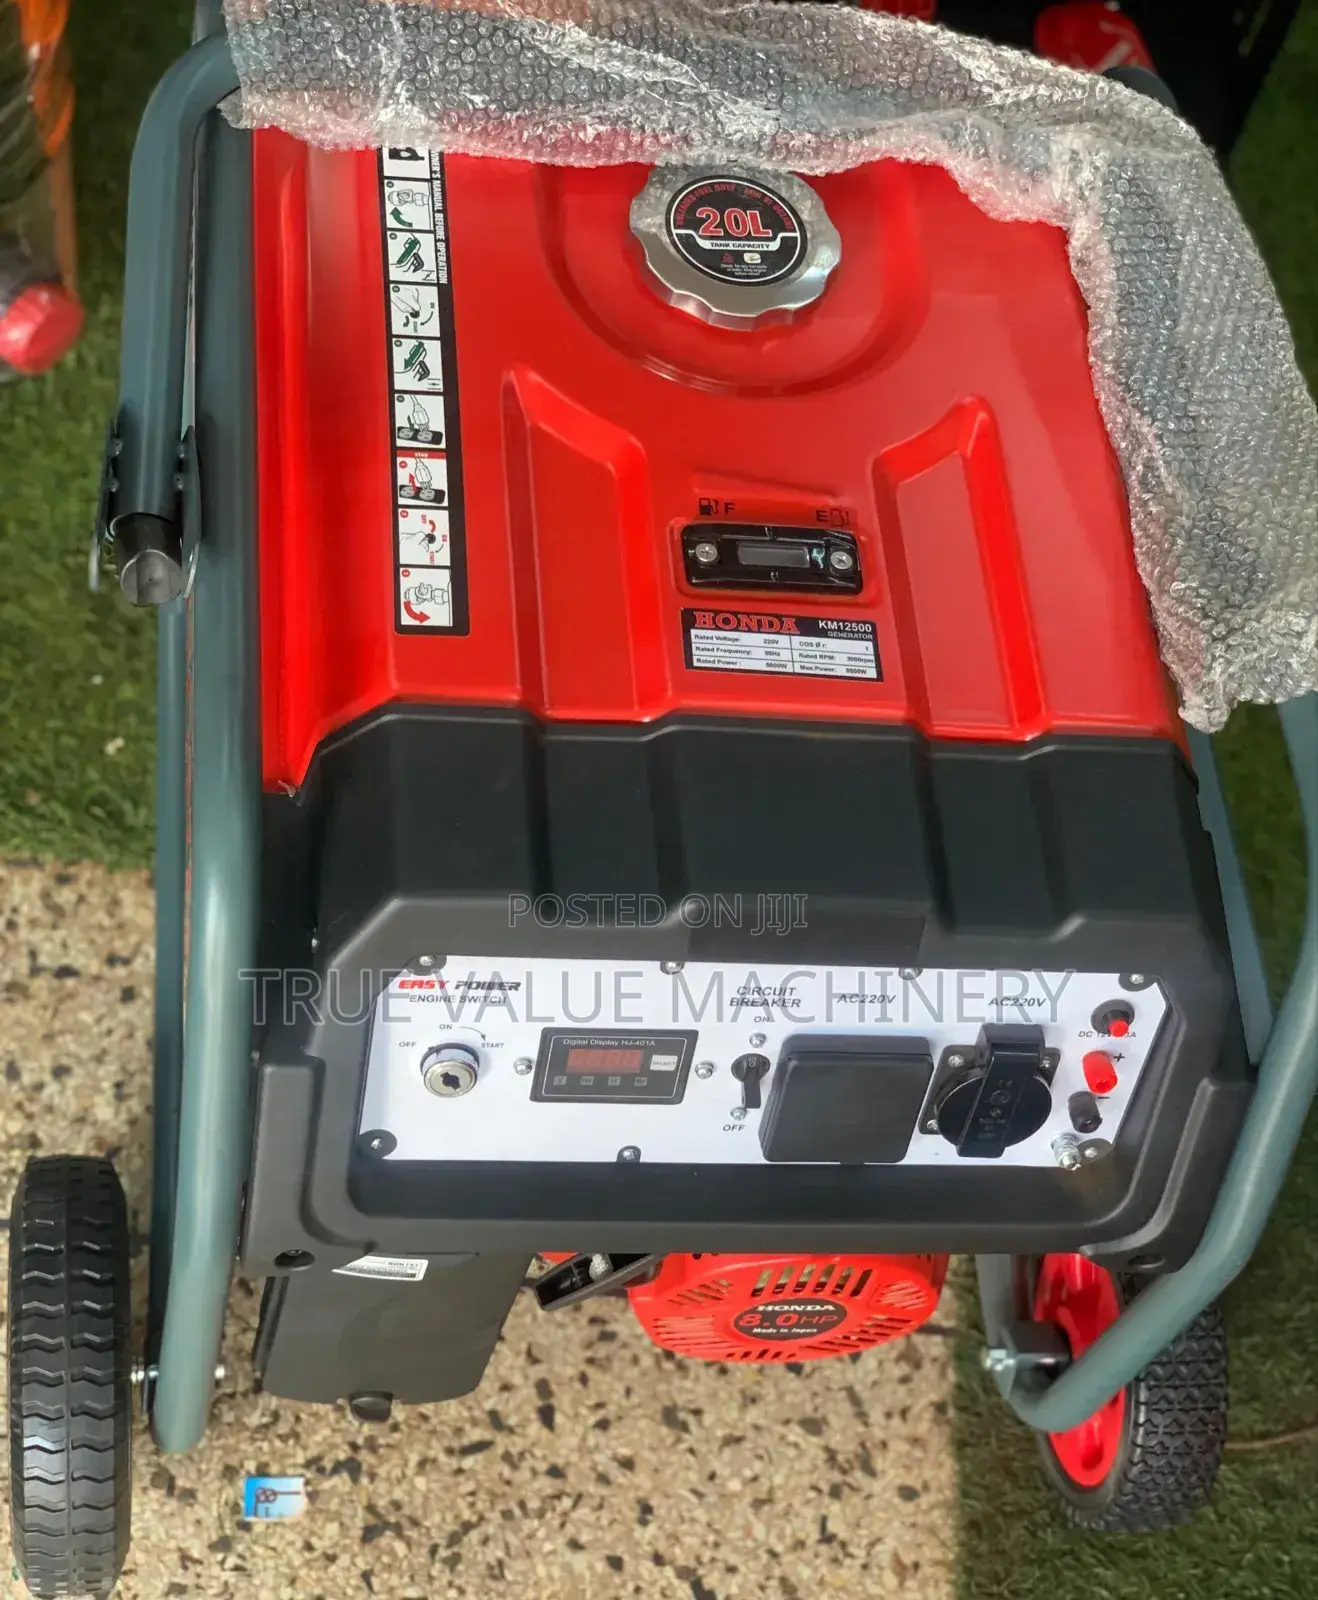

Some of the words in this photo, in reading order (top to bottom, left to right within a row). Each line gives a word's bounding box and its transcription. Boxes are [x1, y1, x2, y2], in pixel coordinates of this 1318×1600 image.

[430, 149, 441, 178] WNER'S
[432, 180, 443, 211] MANUAL
[695, 183, 714, 198] FUEL
[714, 183, 736, 192] ONLY
[434, 213, 445, 240] BEFORE
[696, 207, 773, 237] 20L
[436, 242, 448, 284] OPERATION
[724, 502, 736, 514] F
[816, 510, 829, 522] E
[693, 611, 800, 634] HONDA
[818, 620, 872, 632] KM12500
[715, 635, 742, 643] Voltage:
[827, 631, 874, 640] GENERATOR
[716, 647, 753, 656] Frequency:
[798, 652, 818, 660] Rated
[846, 656, 875, 664] 3000rpm
[398, 980, 450, 990] EASY
[455, 980, 522, 992] POWER
[736, 986, 797, 997] CIRCUIT
[409, 995, 456, 1004] ENGINE
[458, 995, 507, 1004] SWITCH
[729, 998, 802, 1008] BREAKER
[836, 994, 896, 1004] AC220V
[988, 998, 1046, 1008] AC220V
[1078, 1030, 1093, 1038] DC
[722, 1124, 746, 1132] OFF
[756, 1304, 836, 1312] HONDA
